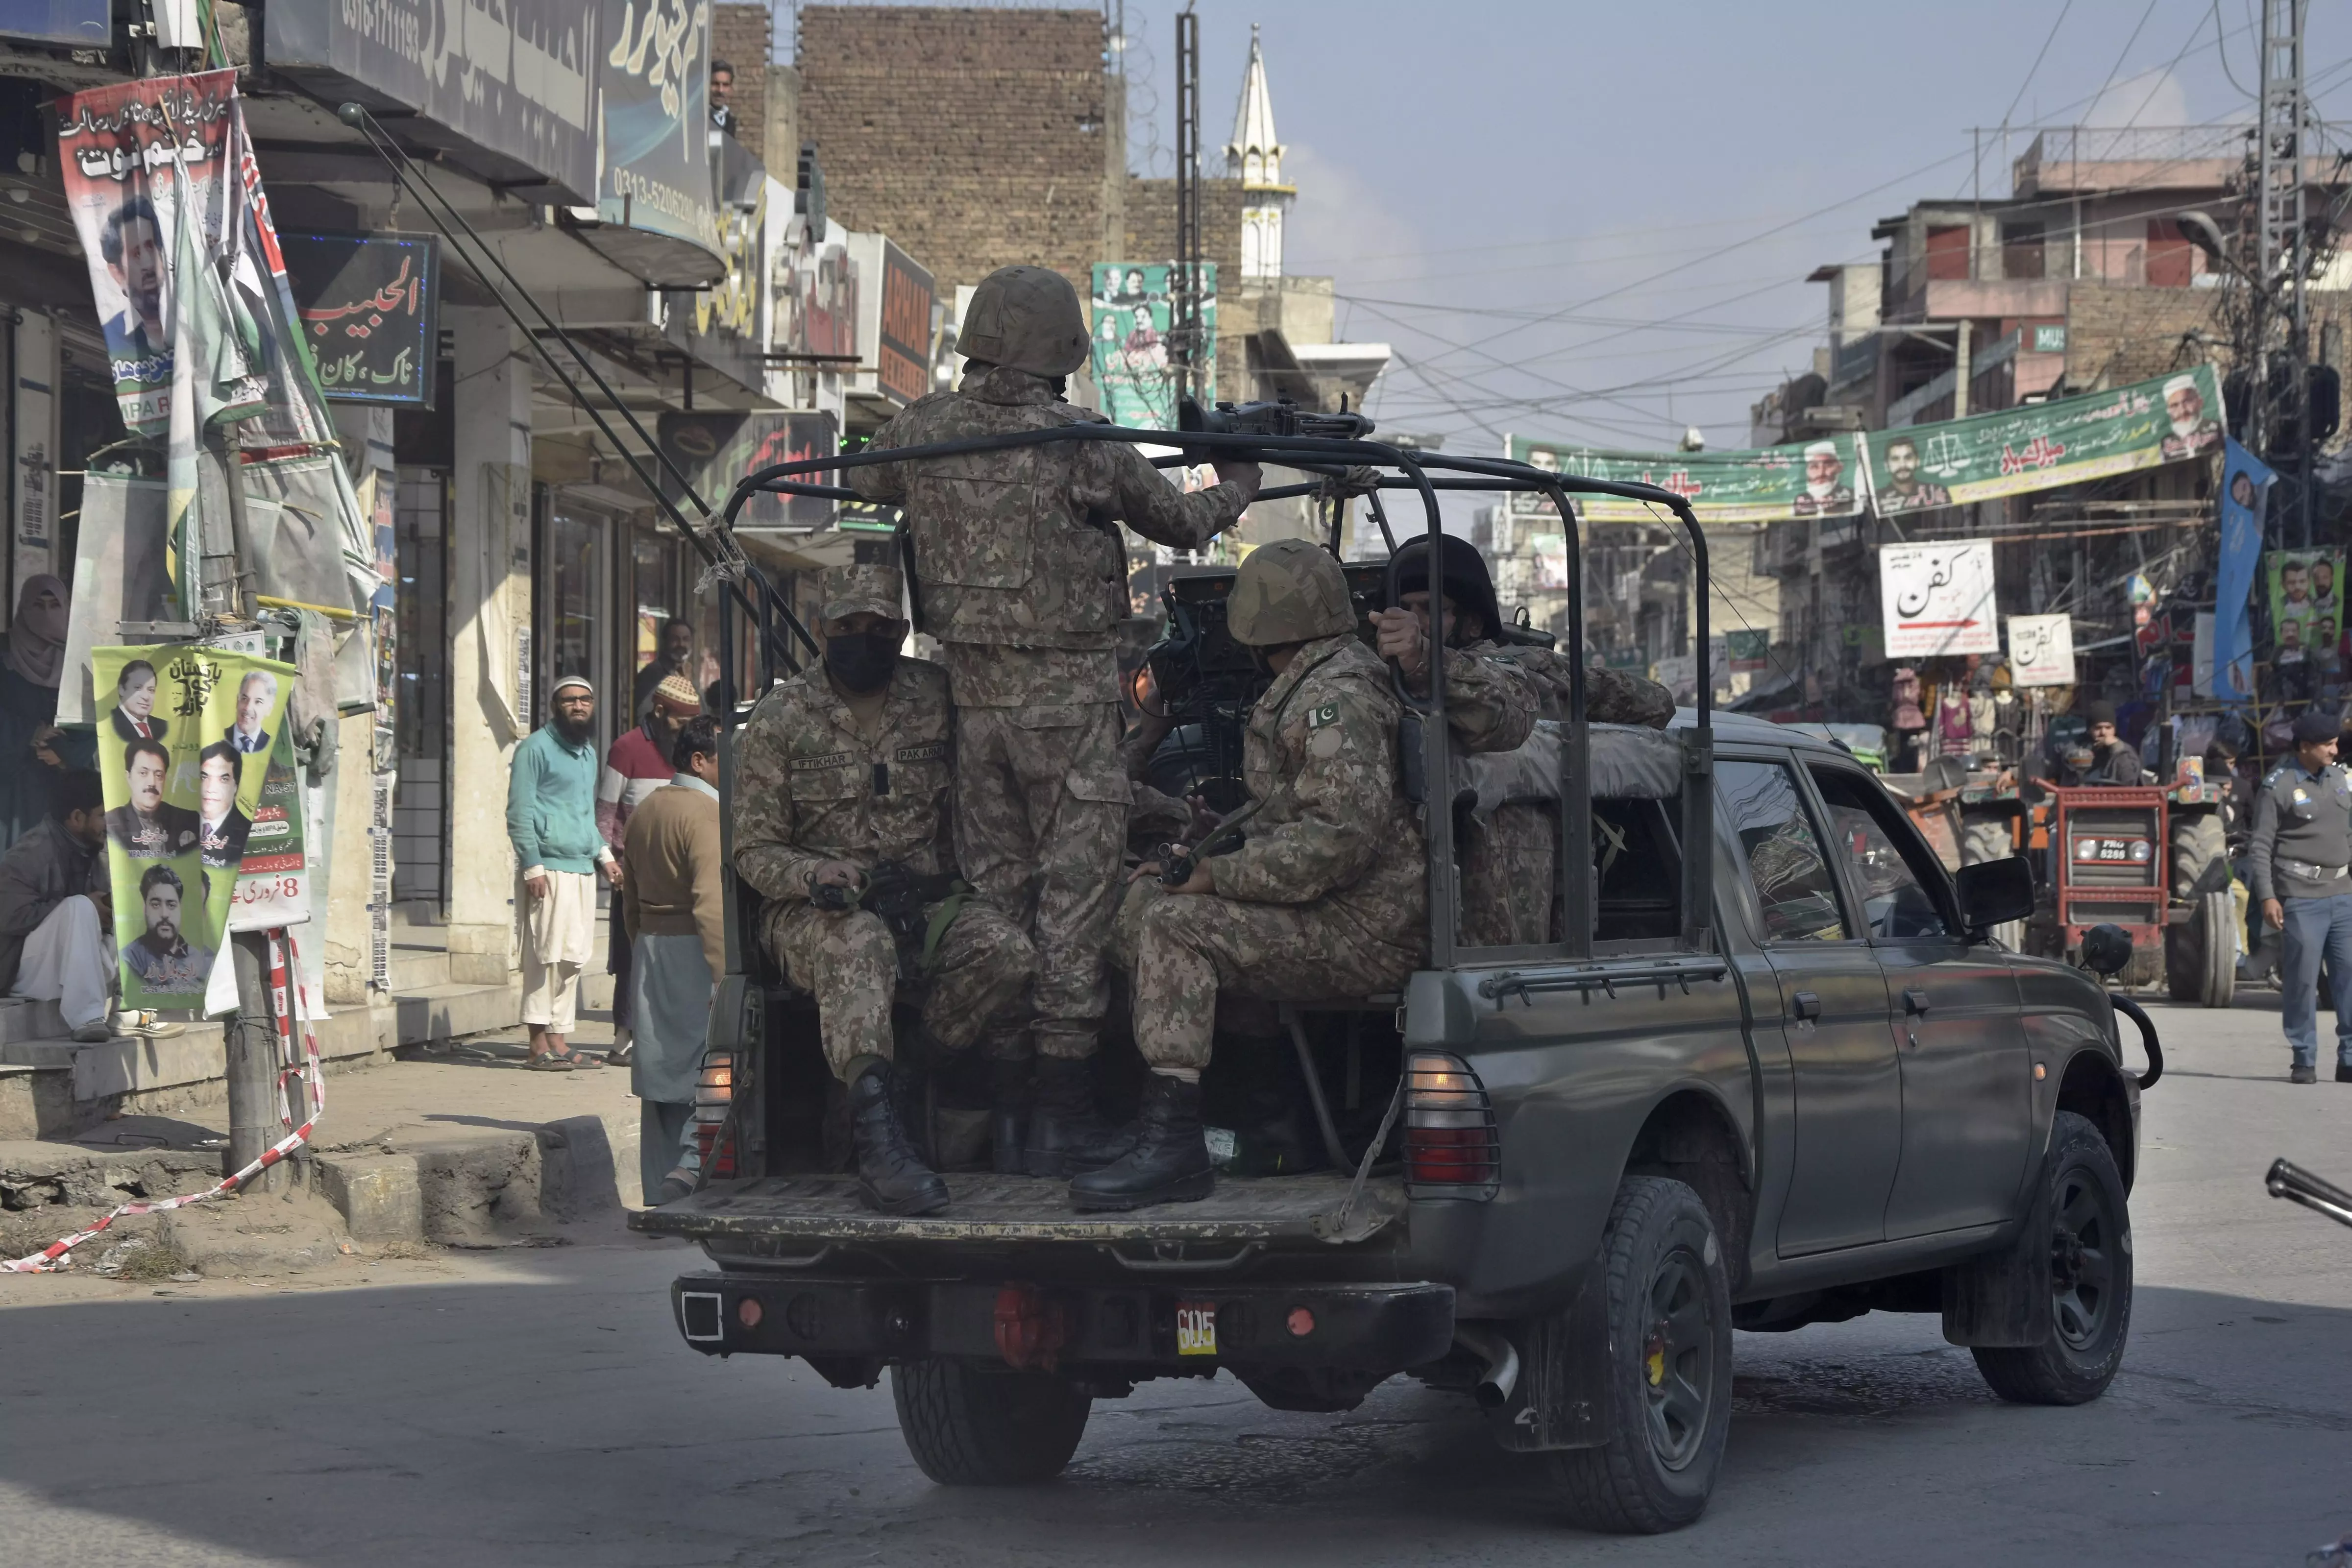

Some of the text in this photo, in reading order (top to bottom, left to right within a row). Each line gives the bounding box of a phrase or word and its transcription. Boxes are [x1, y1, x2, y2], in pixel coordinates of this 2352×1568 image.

[1897, 546, 1972, 619] کفن
[2015, 619, 2064, 666] کفن
[798, 754, 845, 769] IFTIKHAR
[900, 747, 944, 760] PAK ARMY
[265, 783, 295, 795] NA-57
[243, 873, 298, 904] 8 فروری
[1177, 1309, 1215, 1350] 605
